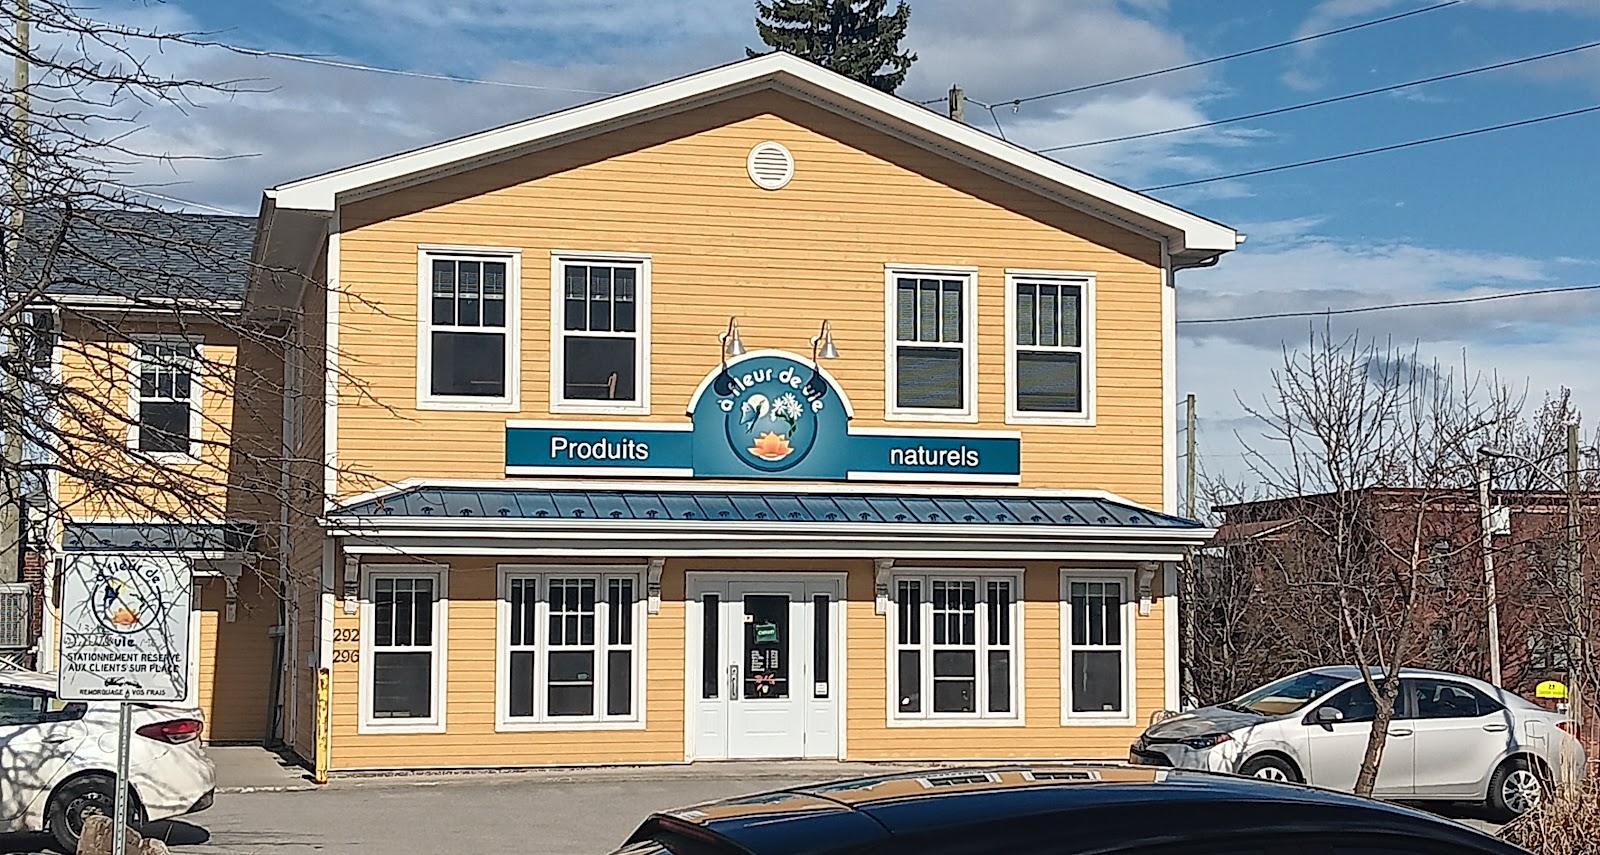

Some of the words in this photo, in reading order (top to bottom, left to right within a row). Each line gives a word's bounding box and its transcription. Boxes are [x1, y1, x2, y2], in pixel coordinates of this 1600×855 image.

[778, 366, 802, 389] de
[550, 436, 649, 461] Produits
[889, 444, 980, 467] naturels
[145, 569, 161, 584] de
[334, 628, 359, 642] 292
[67, 652, 138, 662] STATIONNEMENT
[333, 649, 359, 663] 296
[68, 663, 86, 673] AUX
[89, 663, 127, 673] CLIENTS
[129, 663, 147, 673] SUR
[150, 663, 180, 674] PLACE
